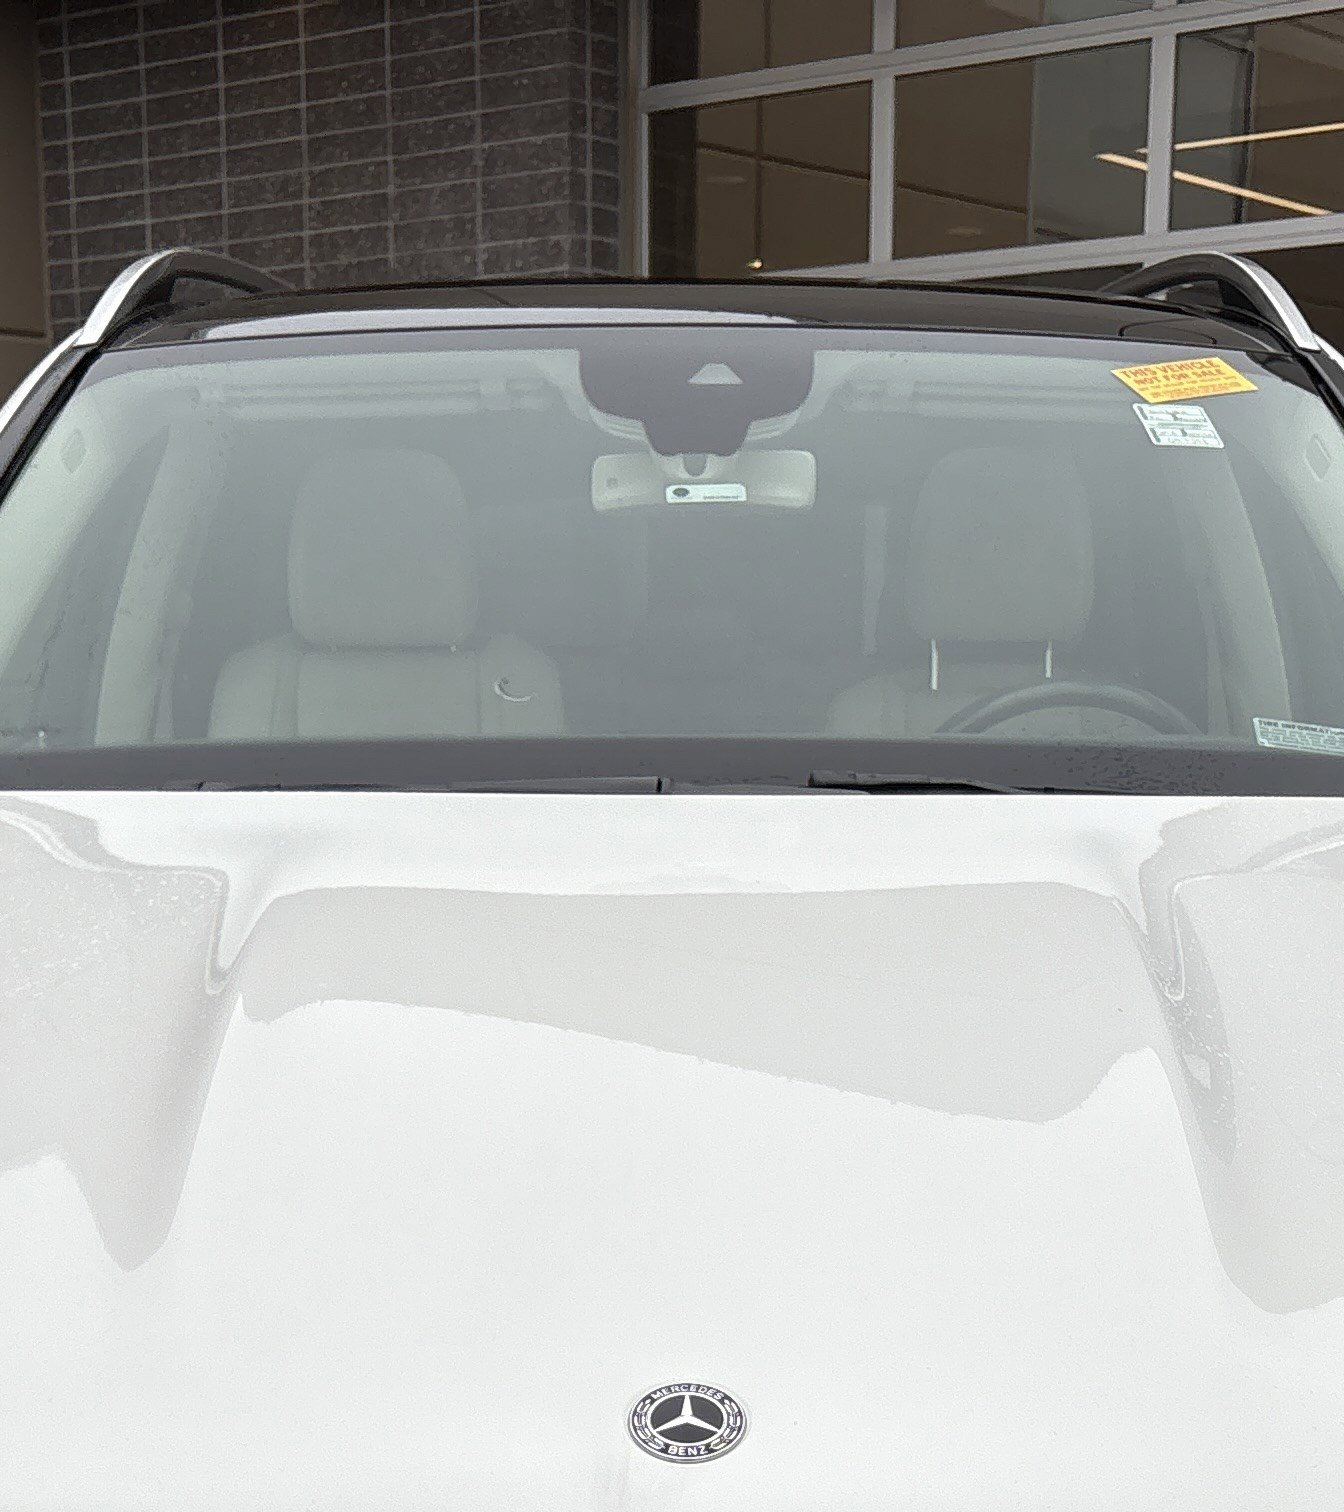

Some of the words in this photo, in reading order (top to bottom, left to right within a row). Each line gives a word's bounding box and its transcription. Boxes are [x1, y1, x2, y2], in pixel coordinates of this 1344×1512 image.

[1120, 367, 1157, 379] THIS
[1158, 360, 1221, 374] VEHICLE
[1133, 376, 1161, 386] NOT
[1162, 373, 1191, 382] FOR
[1192, 368, 1226, 379] SALE
[650, 1384, 725, 1400] MERCEDES
[667, 1445, 709, 1456] BENZ
